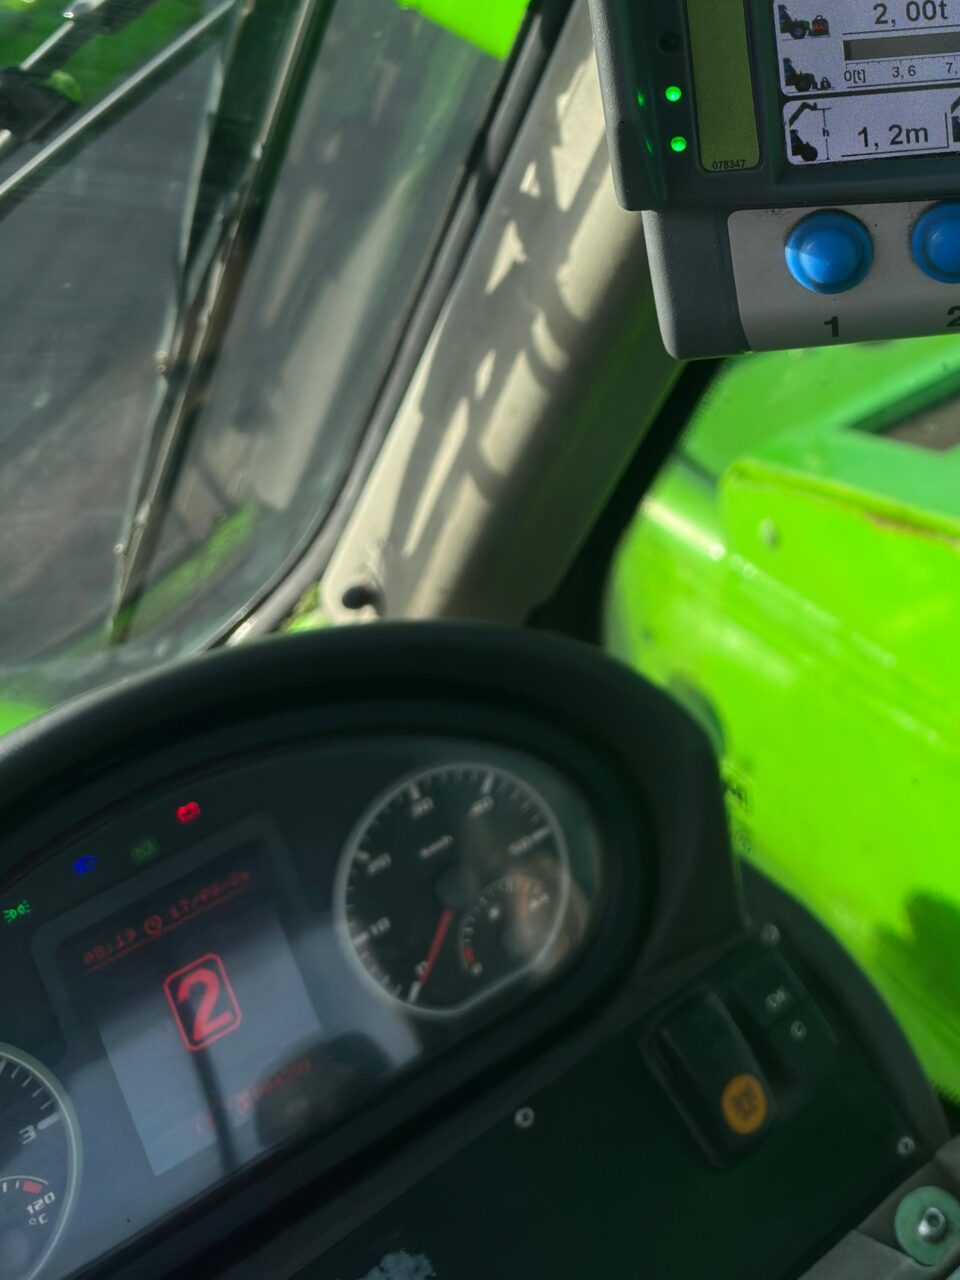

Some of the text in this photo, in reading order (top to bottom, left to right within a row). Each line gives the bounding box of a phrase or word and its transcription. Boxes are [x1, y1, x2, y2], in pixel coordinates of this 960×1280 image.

[712, 160, 746, 169] 078347
[825, 315, 840, 337] 1
[178, 968, 231, 1041] 2
[19, 1125, 37, 1145] 3
[26, 1191, 56, 1216] 120
